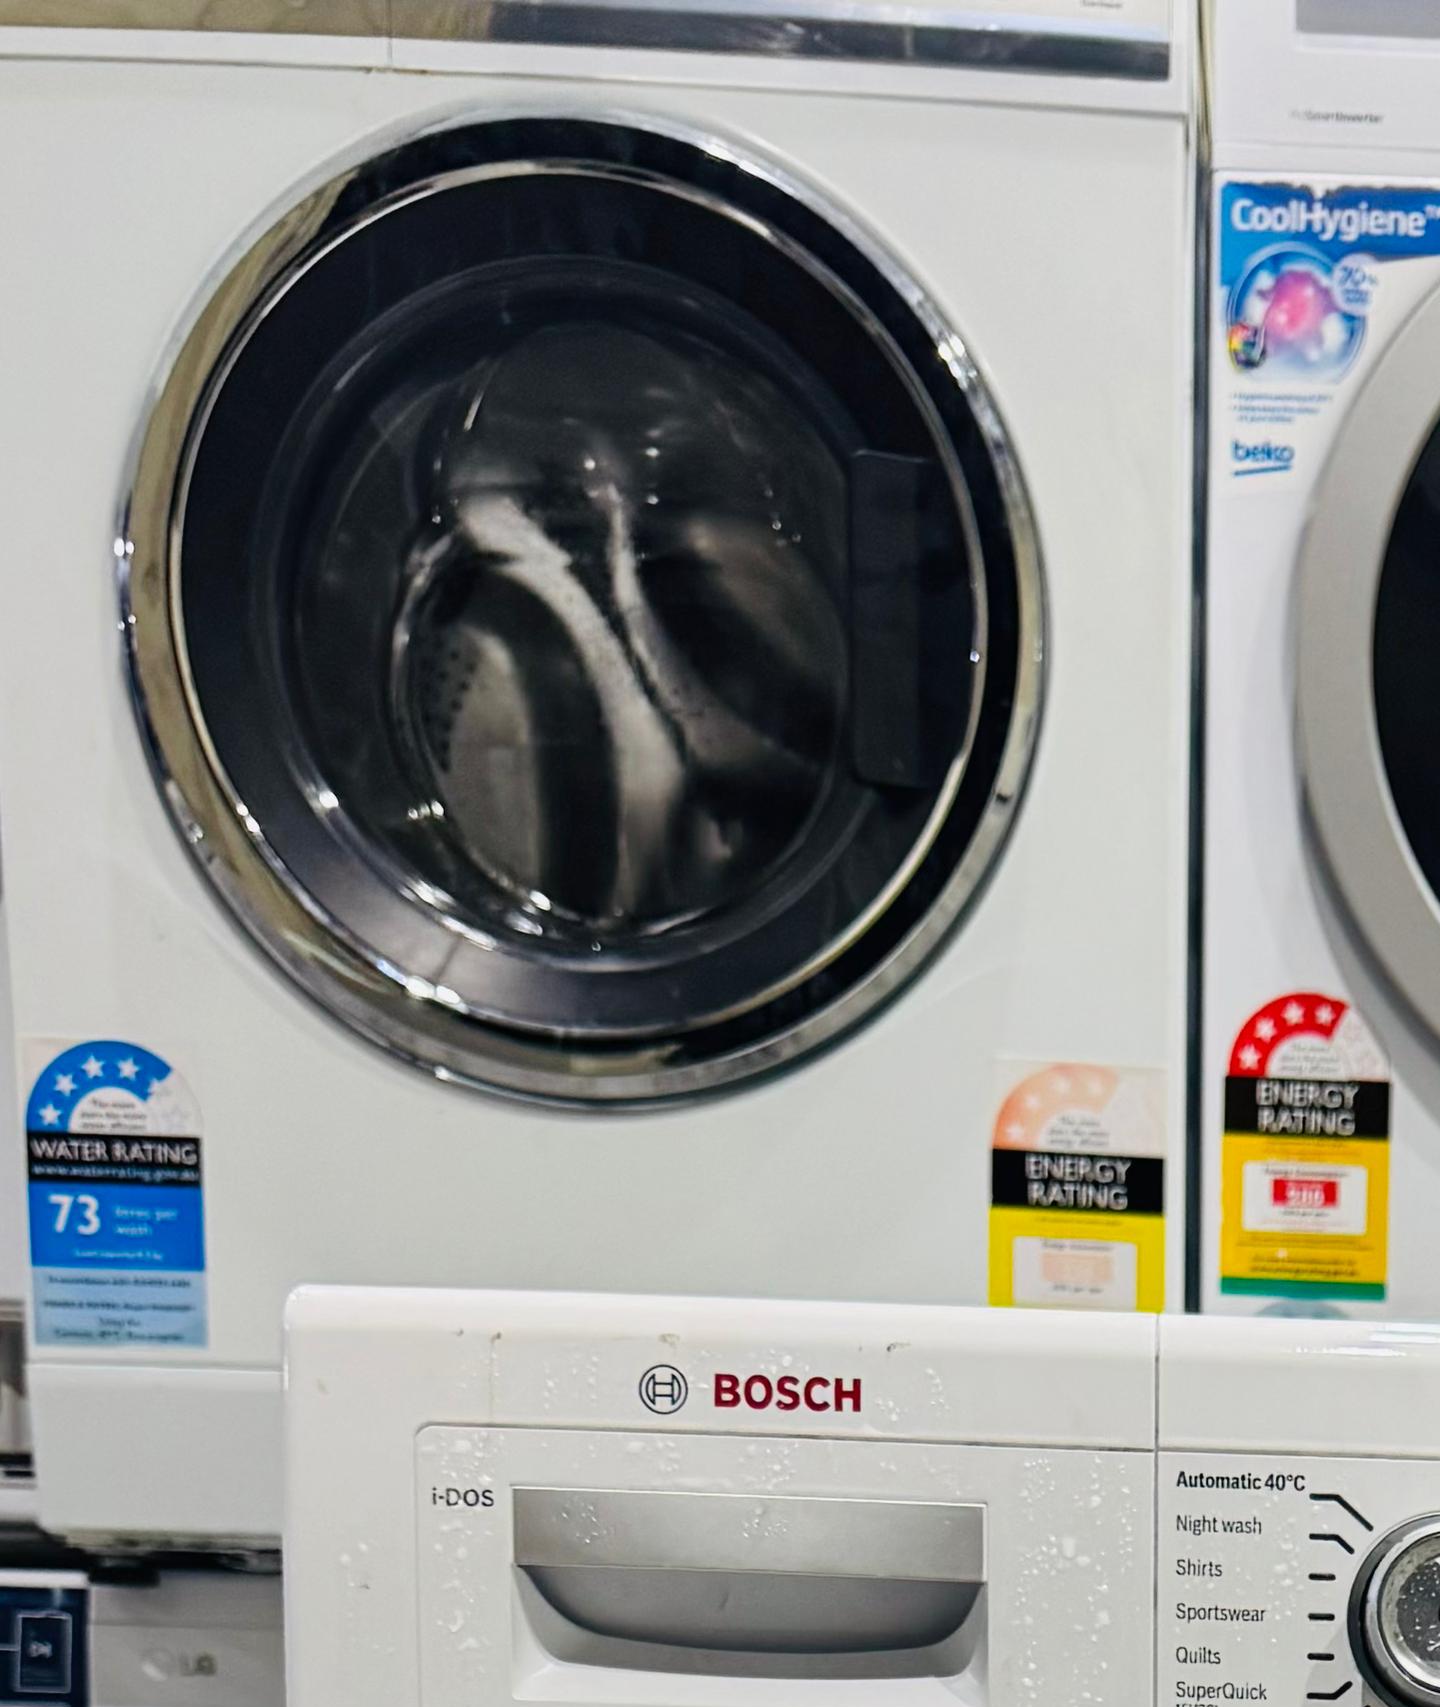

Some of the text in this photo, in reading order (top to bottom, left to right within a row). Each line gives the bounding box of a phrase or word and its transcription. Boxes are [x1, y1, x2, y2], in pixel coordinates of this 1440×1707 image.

[1232, 439, 1294, 464] beko
[1256, 1079, 1360, 1109] ENERGY
[1257, 1106, 1356, 1136] RATING
[31, 1137, 198, 1167] WATER RATING
[1025, 1153, 1132, 1184] ENERGY
[1027, 1181, 1128, 1210] RATING
[49, 1194, 101, 1236] 73
[714, 1374, 862, 1412] BOSCH
[1176, 1471, 1305, 1491] Automatic 40°C
[431, 1487, 494, 1508] i-DOS
[1176, 1514, 1262, 1535] Night wash
[1176, 1559, 1222, 1577] Shirts
[1176, 1602, 1266, 1623] Sportswear
[1176, 1647, 1221, 1665] Quilts
[1176, 1681, 1267, 1701] SuperQuick
